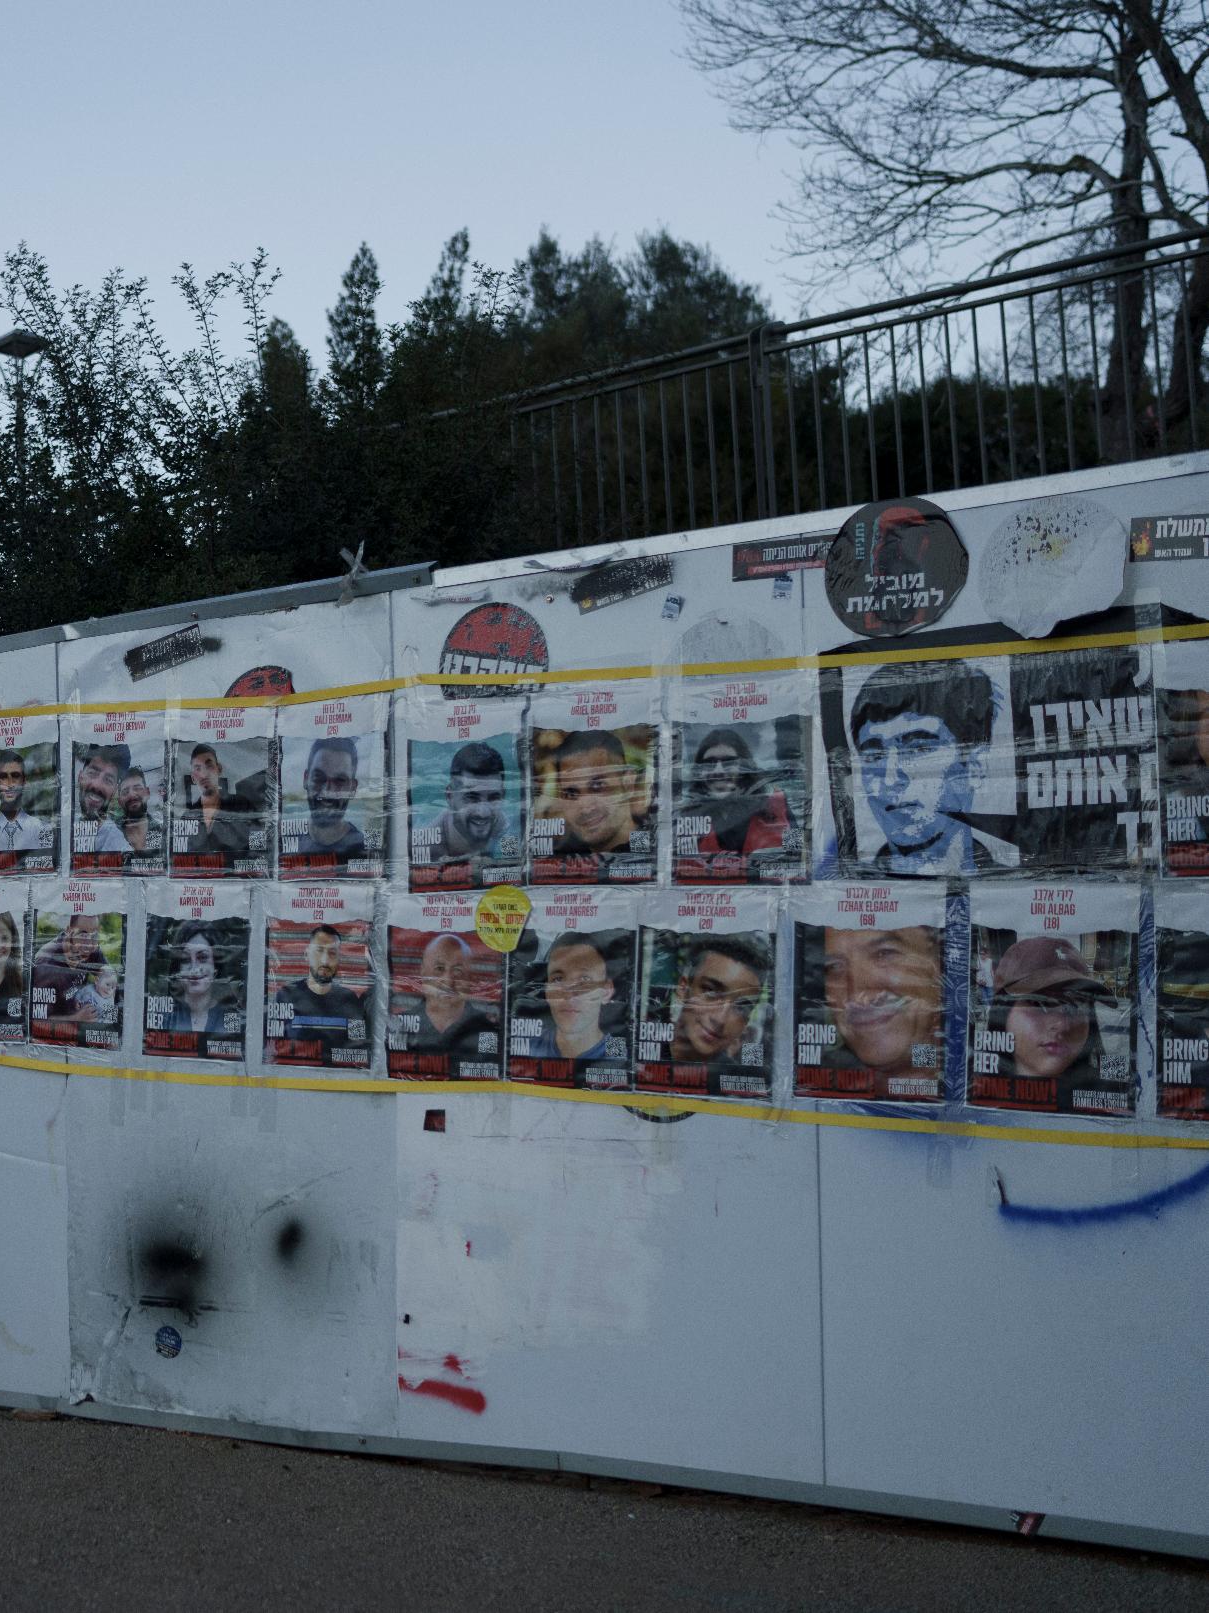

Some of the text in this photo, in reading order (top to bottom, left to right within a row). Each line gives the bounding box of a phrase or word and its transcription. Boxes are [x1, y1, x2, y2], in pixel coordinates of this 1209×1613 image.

[865, 572, 925, 593] מוביל
[571, 703, 617, 716] URIEL BARUCH
[713, 695, 768, 708] SAHAR BARUCH
[732, 708, 748, 720] (24)
[1026, 754, 1128, 809] אותם
[1166, 795, 1209, 819] BRING
[173, 819, 199, 836] BRING
[281, 819, 309, 836] BRING
[533, 818, 566, 837] BRING
[676, 815, 712, 836] BRING
[1167, 817, 1197, 841] HER
[282, 836, 299, 854] HIM
[411, 826, 442, 846] BRING
[676, 836, 700, 854] HIM
[412, 845, 431, 864] HIM
[533, 837, 554, 856] HIM
[871, 888, 891, 901] יצחק
[545, 904, 598, 918] MATAN ANGREST
[677, 905, 736, 918] EDAN ALEXANDER
[837, 900, 899, 913] ITZHAK ELGARAT
[1047, 902, 1076, 916] ALBAG
[698, 918, 713, 931] (20)
[859, 914, 876, 927] (68)
[1043, 916, 1060, 930] (18)
[146, 995, 174, 1013] BRING
[267, 1002, 295, 1020] BRING
[146, 1013, 165, 1030] HER
[266, 1019, 286, 1038] HIM
[510, 1017, 543, 1037] BRING
[639, 1022, 674, 1042] BRING
[797, 1022, 837, 1044] BRING
[974, 1029, 1015, 1052] BRING
[510, 1037, 530, 1056] HIM
[638, 1041, 662, 1061] HIM
[797, 1044, 822, 1066] HIM
[1163, 1037, 1209, 1062] BRING
[974, 1051, 999, 1074] HER
[1163, 1061, 1193, 1085] HIM
[888, 1085, 938, 1096] FAMILIES FORUM
[1072, 1097, 1128, 1110] FAMILIES FORUM
